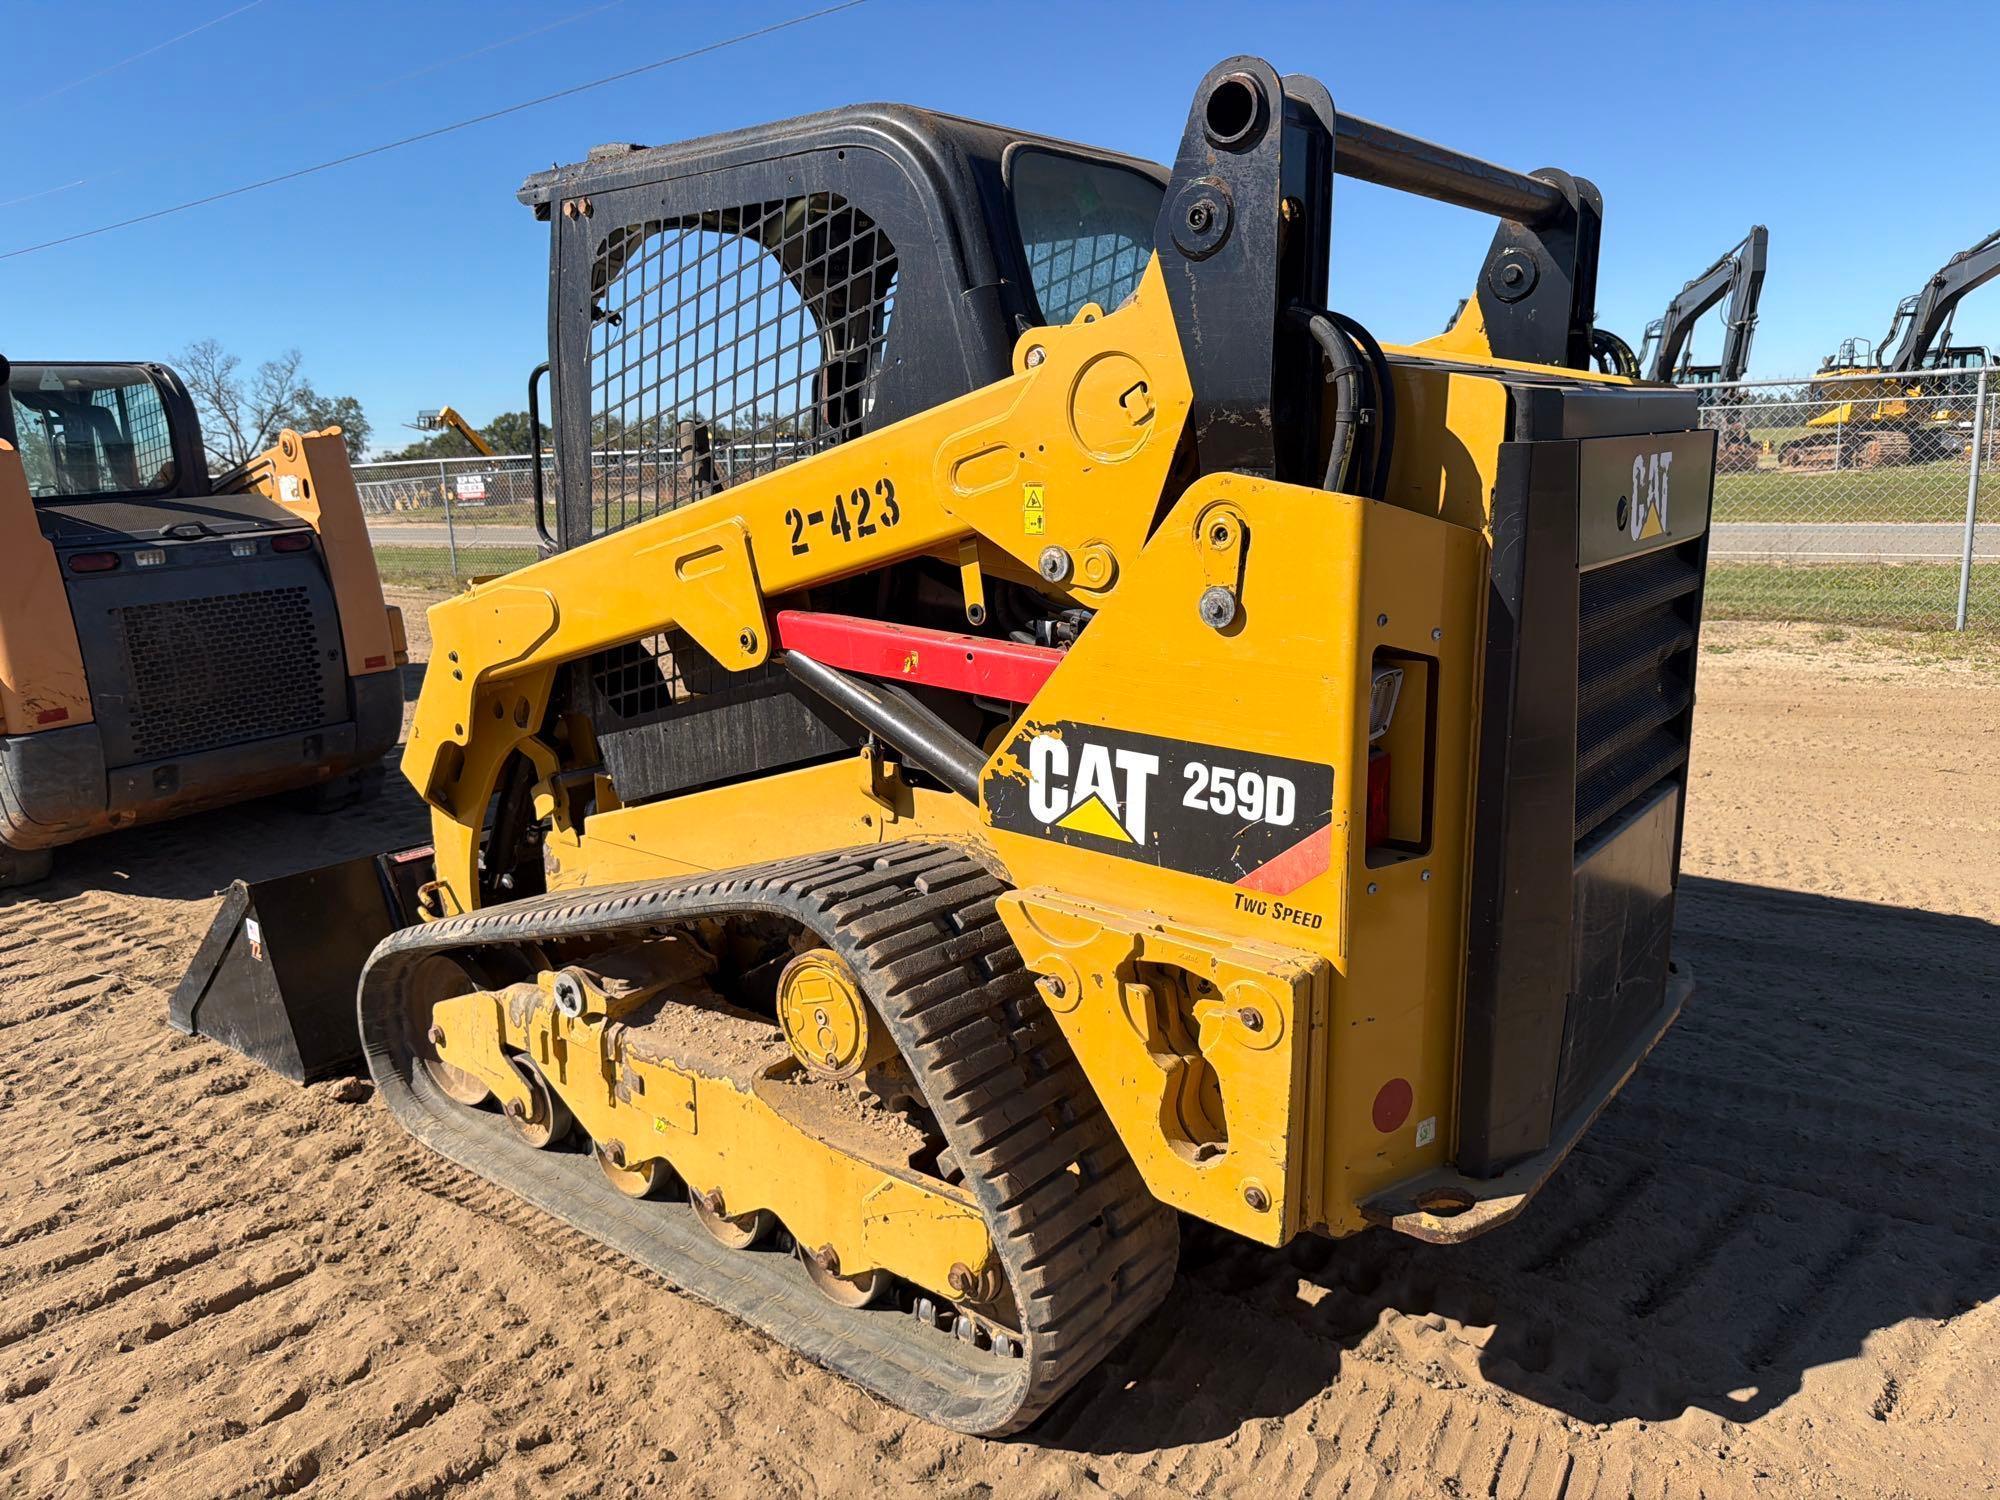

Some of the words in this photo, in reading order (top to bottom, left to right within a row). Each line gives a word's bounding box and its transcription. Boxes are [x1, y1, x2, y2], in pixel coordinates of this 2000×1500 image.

[785, 478, 900, 556] 2-423
[1631, 452, 1673, 541] CAT
[1029, 733, 1159, 846] CAT
[1182, 761, 1297, 826] 259D
[1235, 892, 1267, 916] TWO
[1271, 902, 1323, 929] SPEED
